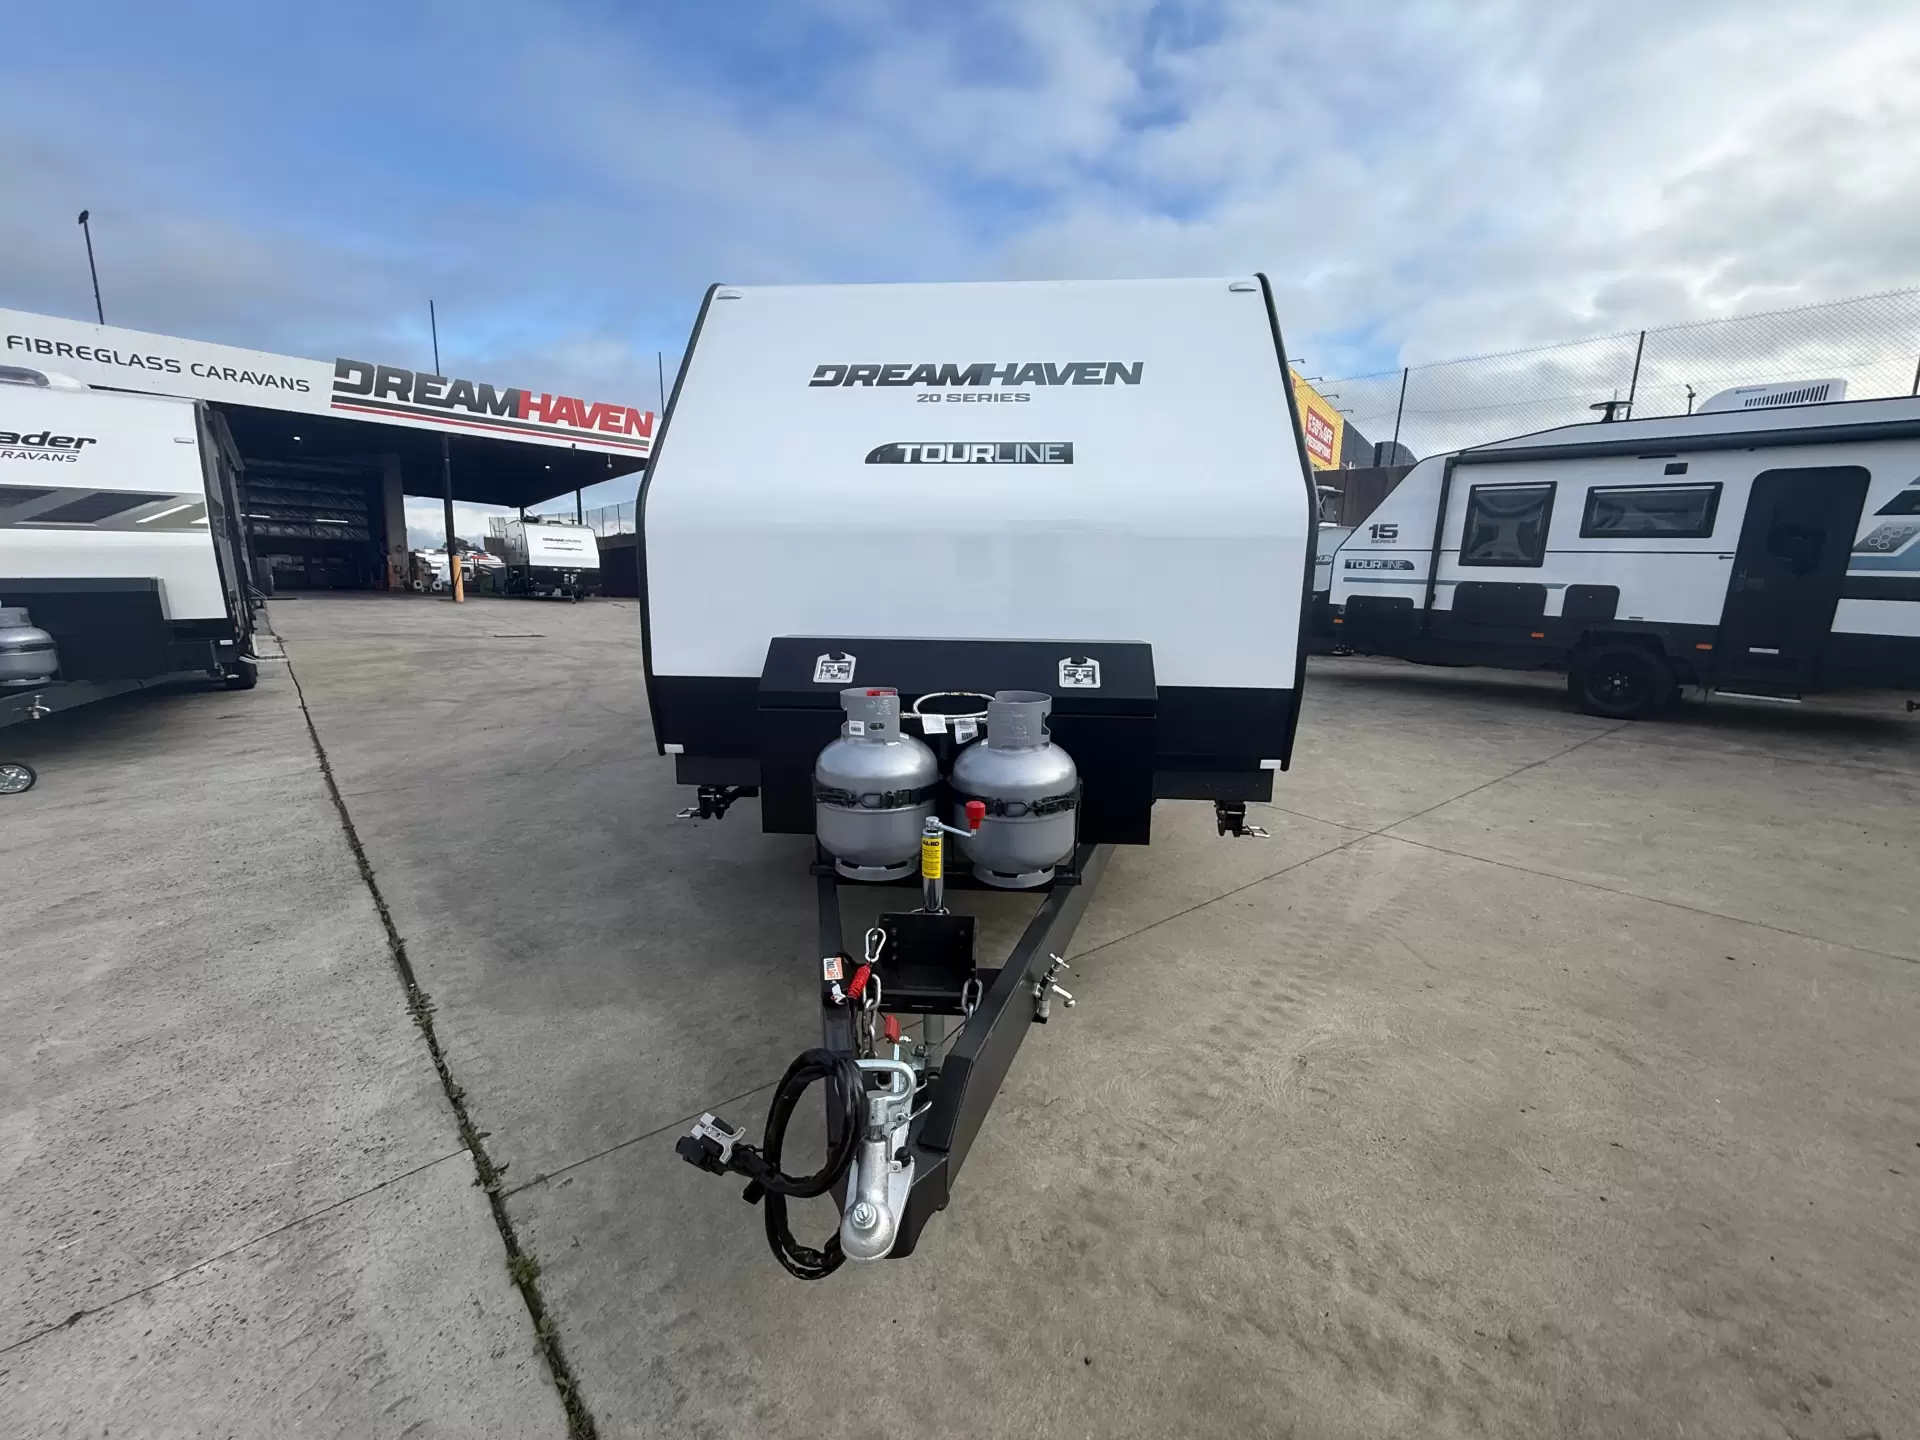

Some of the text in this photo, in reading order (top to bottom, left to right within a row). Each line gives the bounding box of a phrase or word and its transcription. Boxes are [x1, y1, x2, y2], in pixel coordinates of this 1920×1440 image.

[6, 334, 311, 393] FIBREGLASS CARAVANS
[808, 361, 1144, 387] DREAMHAVEN
[333, 357, 655, 438] DREAMHAVEN
[917, 392, 1031, 403] 20 SERIES
[1, 450, 79, 463] RAVANS
[896, 443, 1065, 463] TOURLINE
[1368, 523, 1399, 539] 15
[1348, 560, 1406, 570] TOURLINE
